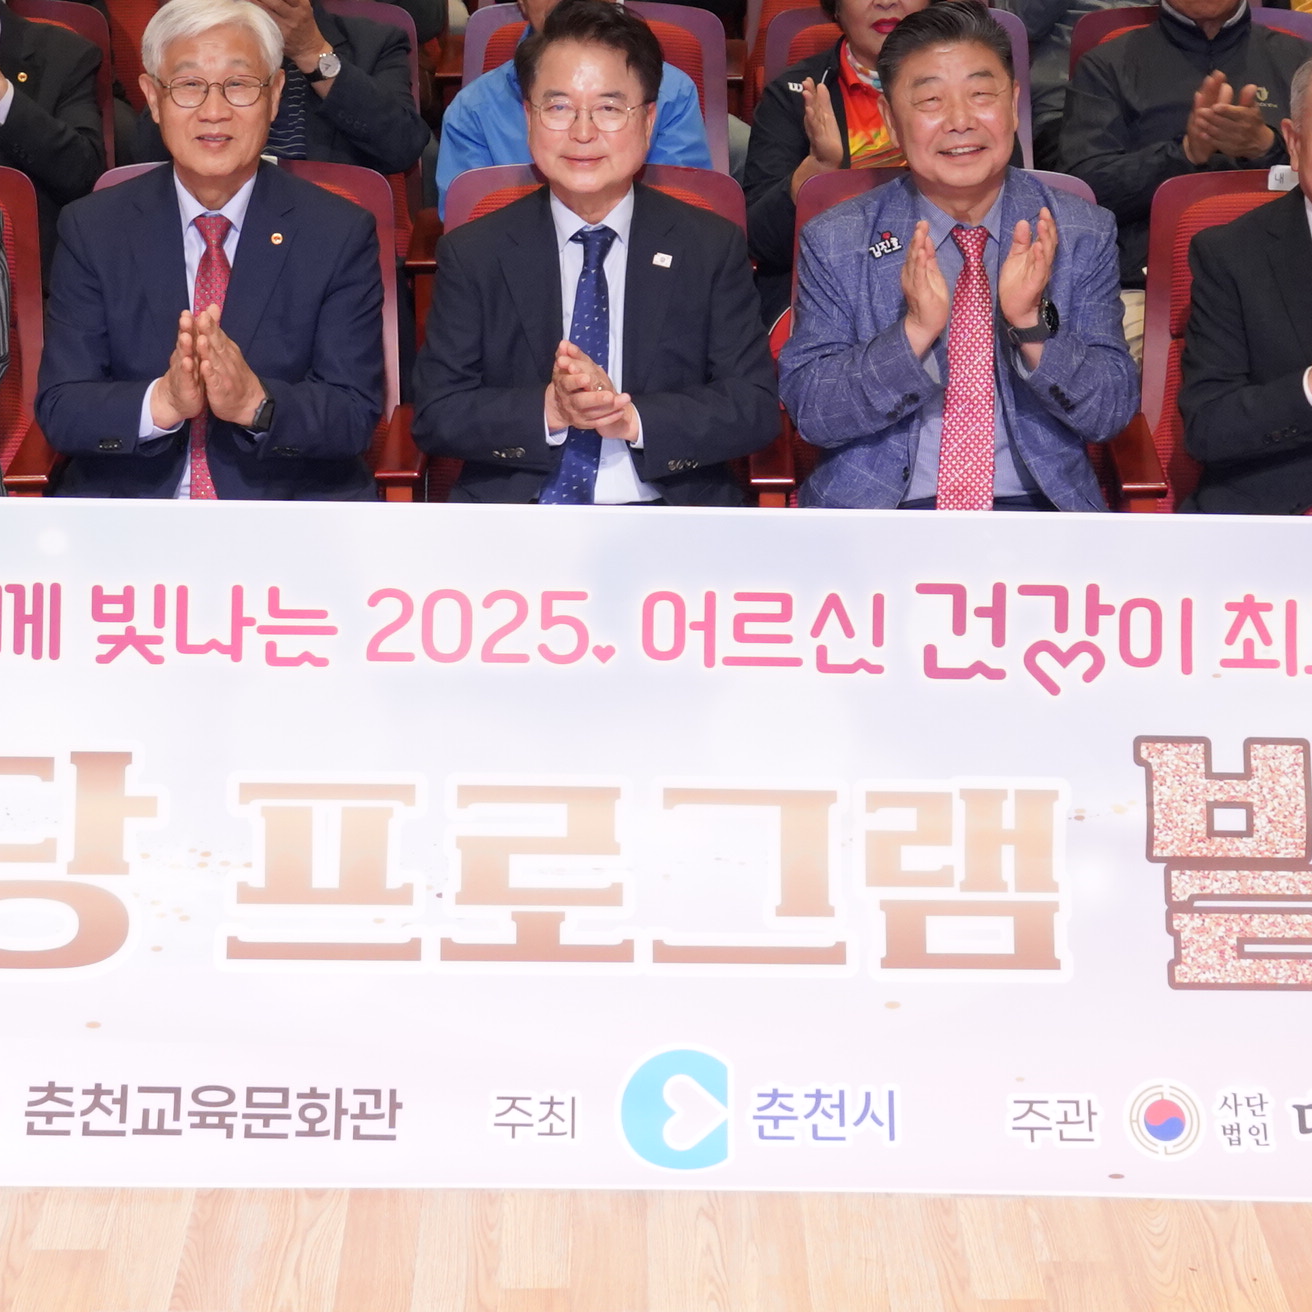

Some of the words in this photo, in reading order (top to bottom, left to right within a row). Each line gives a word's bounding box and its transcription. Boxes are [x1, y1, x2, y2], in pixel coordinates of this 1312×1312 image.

[868, 237, 902, 259] 김진호
[90, 582, 339, 669] 빛나는
[640, 589, 886, 676] 어르신
[914, 581, 1194, 696] 건강이
[225, 781, 1063, 972] 프로그램
[24, 1081, 404, 1141] 춘천교육문화관
[493, 1095, 576, 1139] 주최
[751, 1088, 900, 1142] 춘천시
[1011, 1099, 1098, 1143] 주관
[1220, 1092, 1268, 1118] 사단
[1221, 1121, 1269, 1147] 법인
